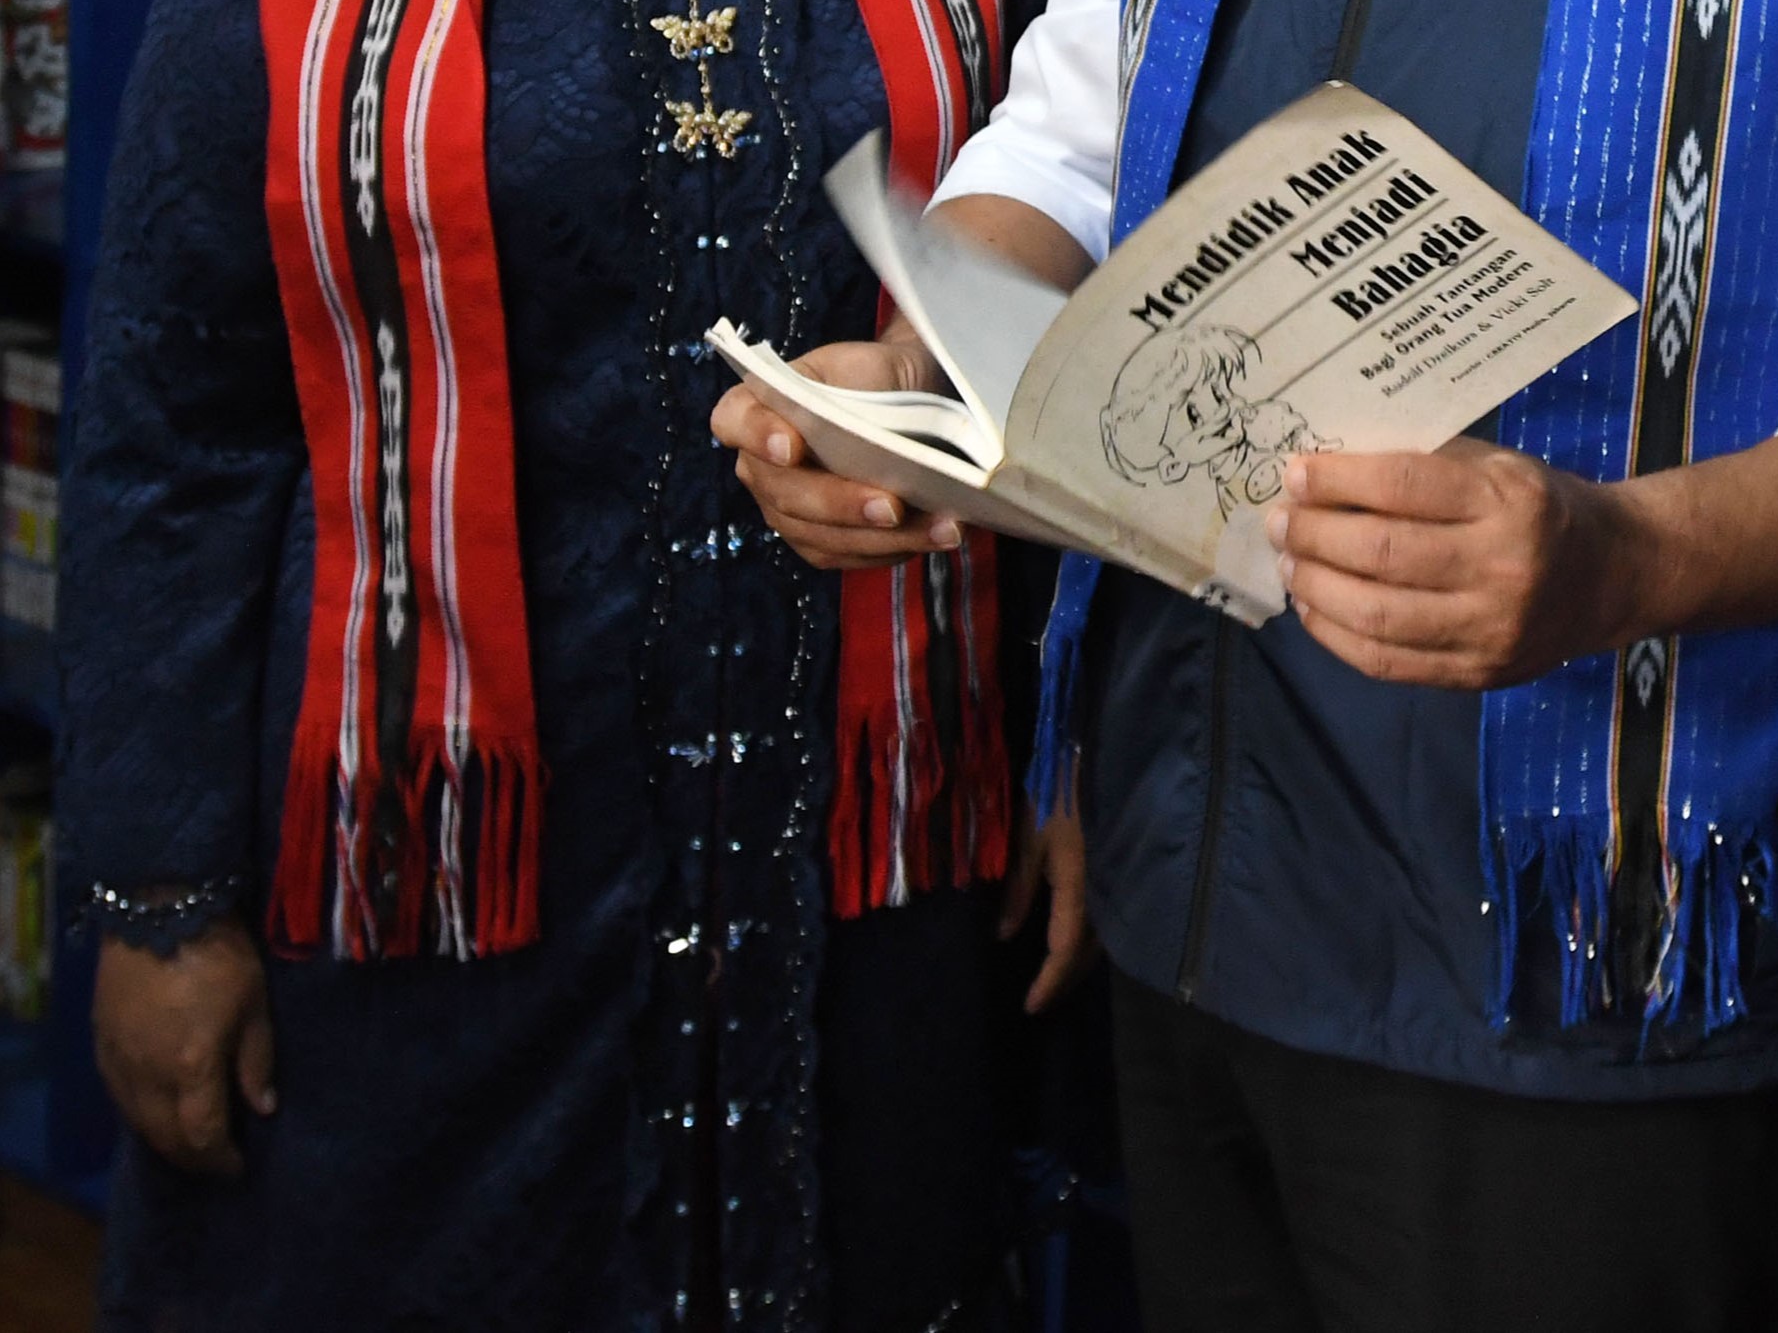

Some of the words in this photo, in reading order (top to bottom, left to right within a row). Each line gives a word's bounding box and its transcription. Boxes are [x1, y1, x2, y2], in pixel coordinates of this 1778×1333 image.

[1129, 195, 1298, 334] Mendidik
[1284, 129, 1389, 209] Anak
[1288, 167, 1440, 280] Menjadi
[1329, 214, 1490, 324] Bahagia
[1359, 352, 1396, 381] Bagi
[1394, 322, 1447, 358] Orang
[1441, 302, 1475, 325] Tua
[1470, 259, 1535, 304] Modern
[1380, 301, 1438, 344] Sebuah
[1433, 248, 1519, 305] Tantangan
[1380, 363, 1425, 399] Rudolf
[1424, 330, 1479, 370] Dreikurs
[1477, 321, 1493, 333] &
[1489, 296, 1530, 322] Vicki
[1526, 275, 1557, 299] Solt
